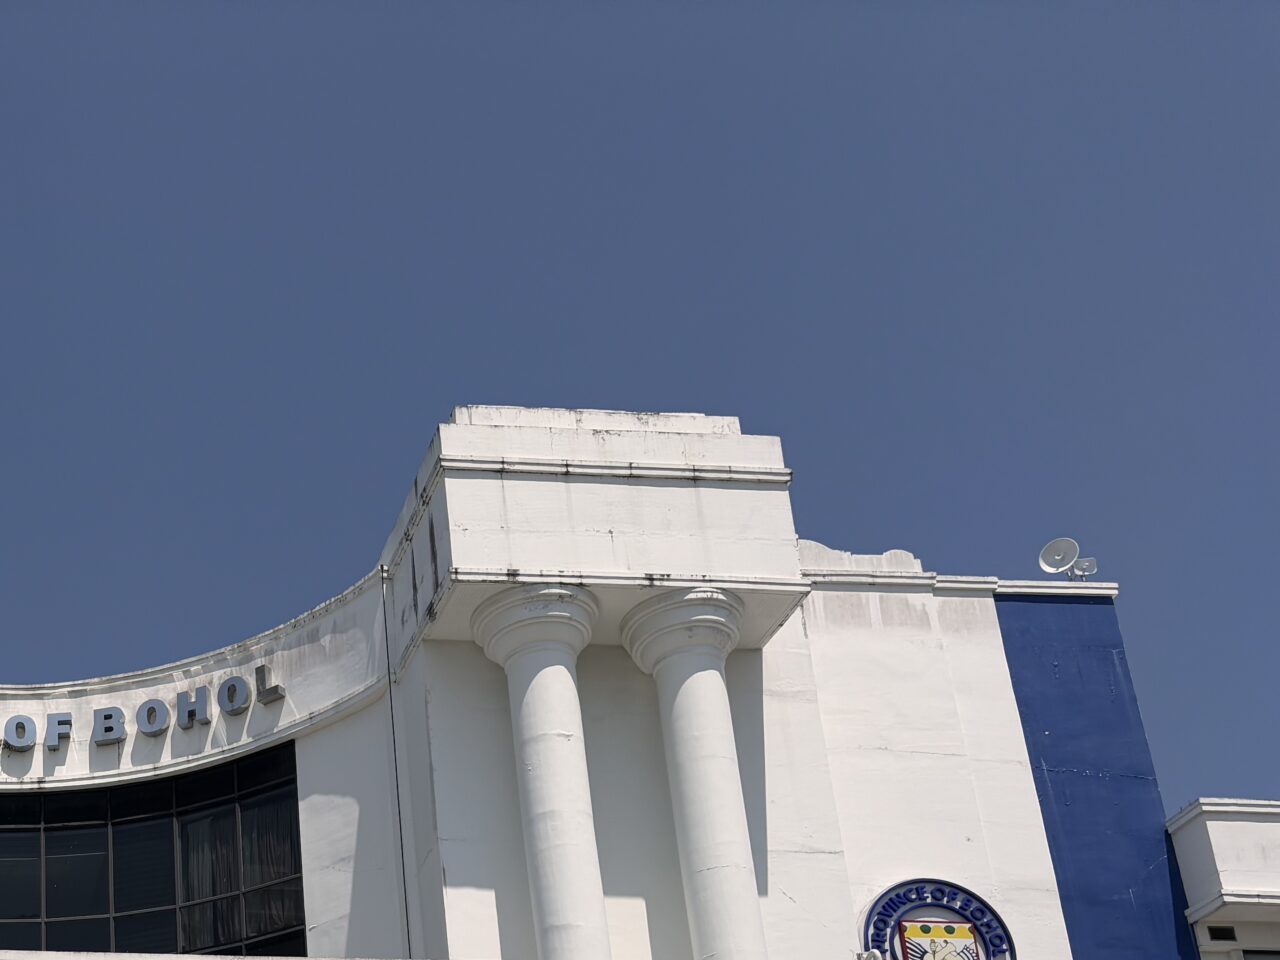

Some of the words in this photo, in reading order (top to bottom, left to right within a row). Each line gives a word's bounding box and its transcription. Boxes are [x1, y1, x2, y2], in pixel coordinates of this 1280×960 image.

[3, 712, 72, 752] OF
[93, 664, 286, 746] BOHOL
[871, 885, 927, 954] PROVINCE
[930, 885, 960, 904] OF
[961, 896, 1009, 959] BOHOL
